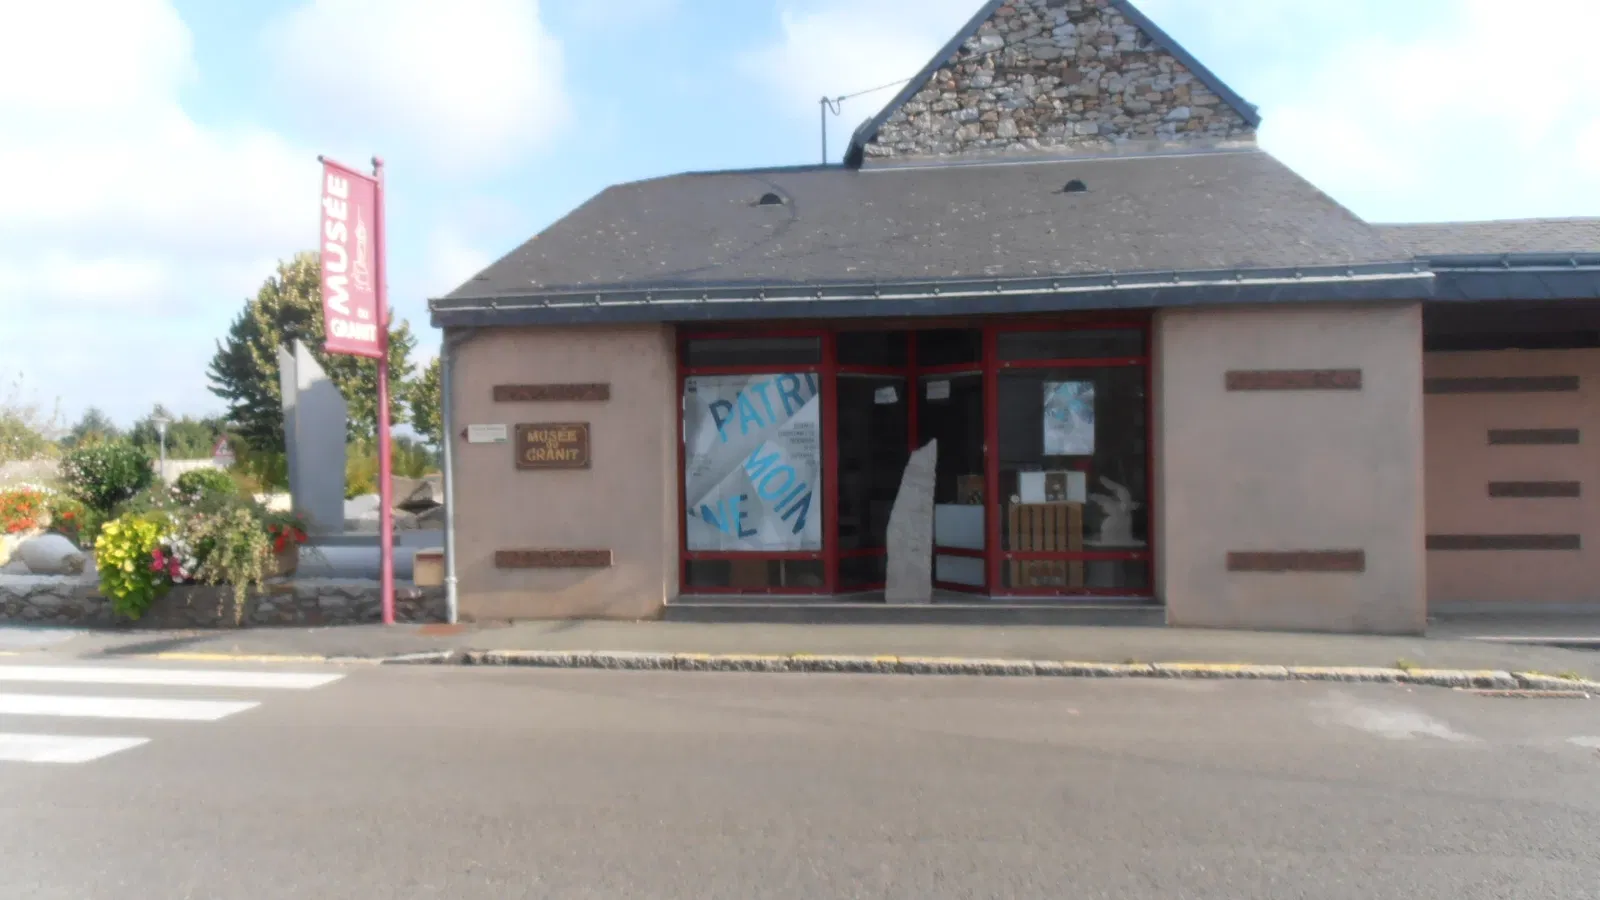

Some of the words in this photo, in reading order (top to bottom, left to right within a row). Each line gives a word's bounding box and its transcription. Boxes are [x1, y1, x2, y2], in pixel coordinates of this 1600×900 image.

[323, 173, 350, 316] MUSÉE
[527, 426, 577, 443] MUSÉE
[525, 447, 580, 462] GRANIT
